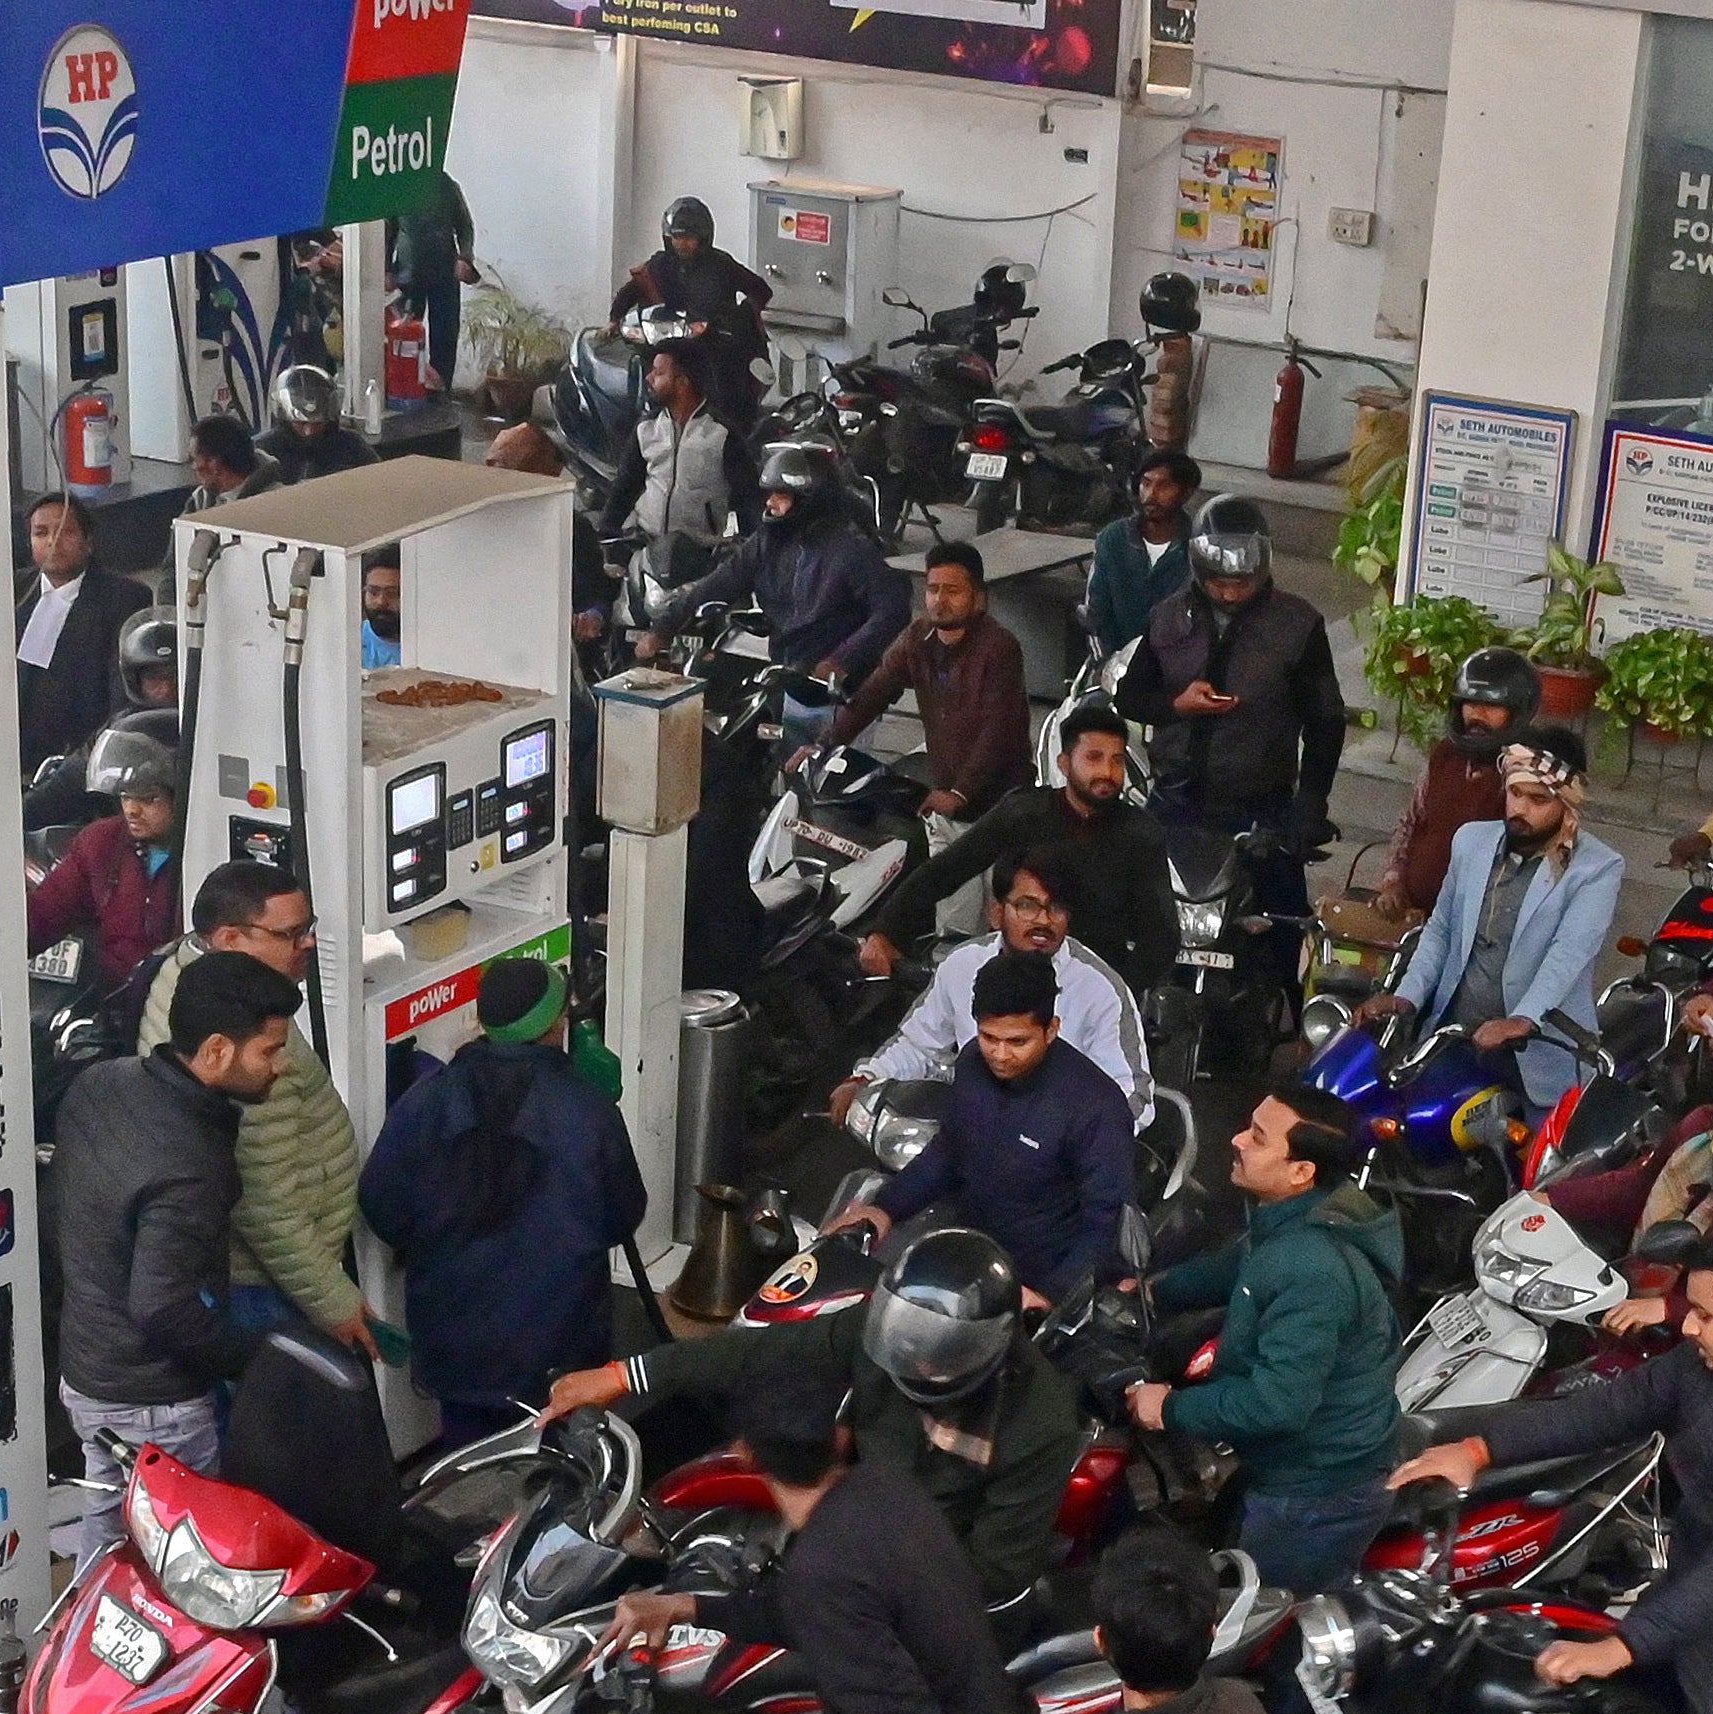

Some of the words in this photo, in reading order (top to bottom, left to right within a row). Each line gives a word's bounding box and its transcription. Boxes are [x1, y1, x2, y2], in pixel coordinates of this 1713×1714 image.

[601, 11, 628, 26] best
[65, 51, 119, 104] HP
[352, 117, 433, 180] Petrol
[1459, 419, 1486, 433] SETH
[1487, 423, 1557, 443] AUTOMOBILES
[1668, 455, 1695, 470] SETH
[1498, 1541, 1540, 1567] 125
[668, 1622, 727, 1649] TVS
